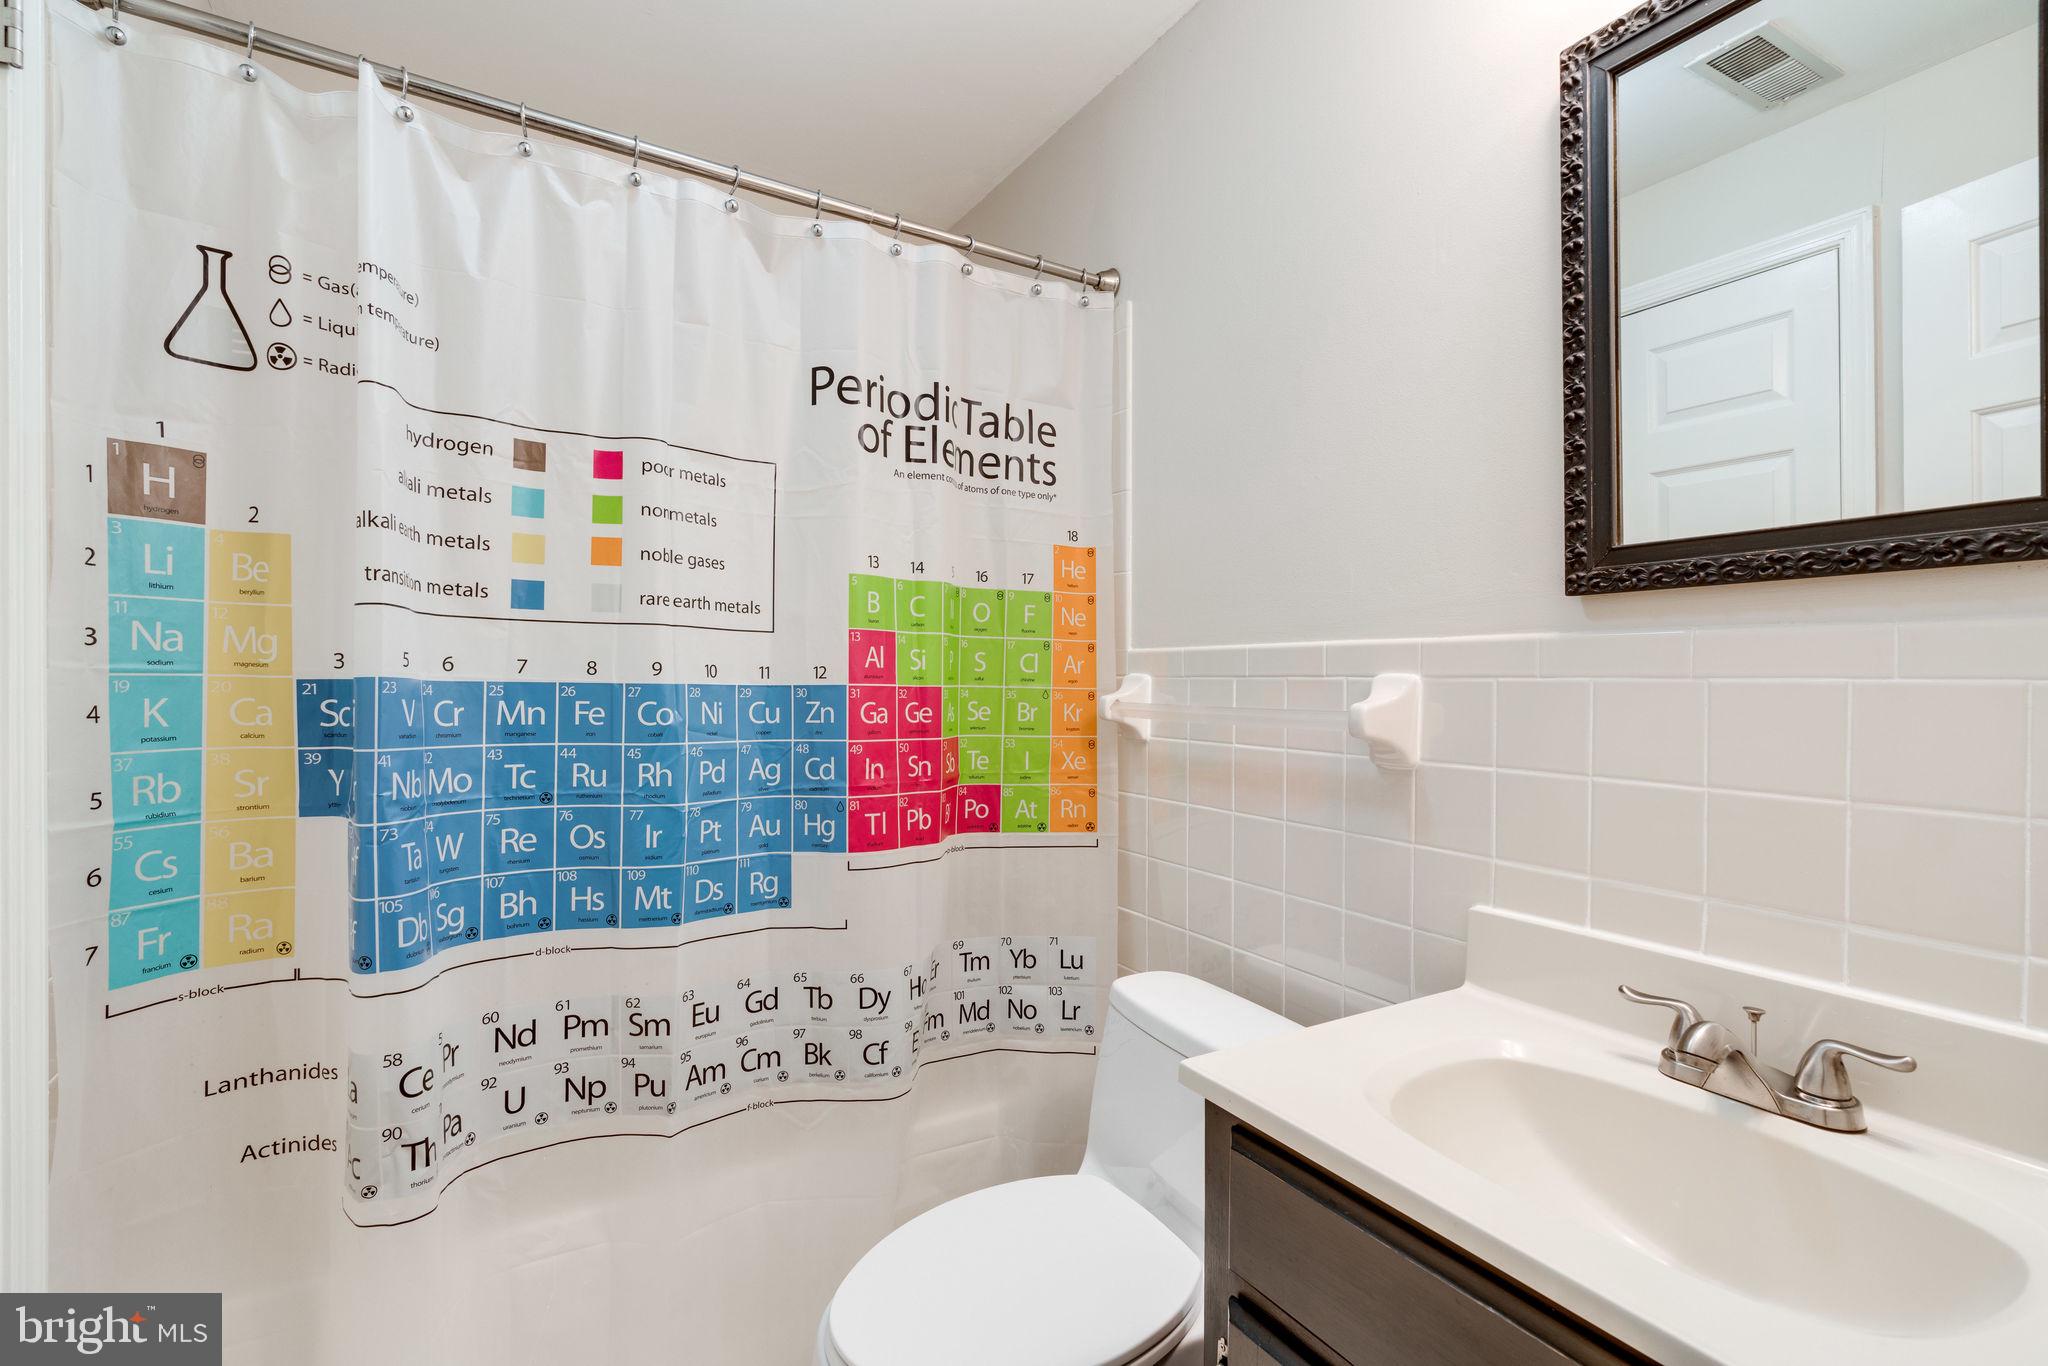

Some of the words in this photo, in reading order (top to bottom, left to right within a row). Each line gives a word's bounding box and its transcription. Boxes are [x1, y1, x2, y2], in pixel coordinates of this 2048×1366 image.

[319, 316, 358, 338] Liqu
[319, 358, 358, 376] Radi
[811, 365, 958, 429] Periodic
[961, 397, 1057, 448] Table
[155, 421, 164, 438] 1
[406, 424, 494, 457] hydrogen
[858, 419, 893, 458] of
[905, 425, 1057, 487] Elements
[86, 464, 92, 482] 1
[143, 463, 175, 498] H
[680, 469, 726, 487] metals
[894, 469, 904, 479] An
[907, 471, 944, 481] element
[964, 485, 988, 494] atoms
[991, 485, 1000, 495] of
[1019, 490, 1035, 499] type
[427, 486, 492, 503] metals
[248, 506, 259, 523] 2
[427, 534, 491, 551] metals
[1067, 531, 1078, 542] 18
[85, 547, 96, 566] 2
[145, 544, 173, 575] Li
[641, 548, 683, 564] noble
[688, 556, 725, 570] gases
[868, 555, 879, 568] 13
[232, 553, 269, 582] Be
[911, 562, 924, 573] 14
[976, 571, 988, 582] 16
[1061, 560, 1086, 579] He
[148, 582, 174, 590] lithium
[1022, 573, 1034, 584] 17
[427, 582, 489, 598] metals
[640, 594, 670, 606] rare
[673, 596, 710, 610] earth
[715, 601, 760, 614] metals
[868, 592, 880, 613] B
[910, 596, 925, 617] C
[973, 603, 990, 623] O
[1025, 605, 1034, 624] F
[84, 627, 97, 645] 3
[131, 620, 183, 652] Na
[223, 625, 278, 663] Mg
[334, 653, 344, 669] 3
[403, 652, 409, 667] 5
[442, 656, 454, 671] 6
[517, 659, 528, 674] 7
[865, 646, 884, 668] Al
[910, 649, 925, 671] Si
[974, 652, 986, 672] S
[1020, 653, 1038, 673] Cl
[587, 661, 597, 675] 8
[652, 662, 662, 676] 9
[705, 664, 717, 678] 10
[759, 666, 769, 679] 11
[814, 666, 827, 679] 12
[302, 684, 317, 694] 21
[489, 686, 504, 696] 25
[561, 686, 575, 696] 26
[740, 689, 751, 697] 29
[86, 705, 100, 723] 4
[144, 698, 169, 728] K
[434, 700, 464, 726] Cr
[497, 700, 545, 725] Mn
[575, 701, 605, 725] Fe
[637, 701, 673, 726] Co
[702, 702, 722, 724] Ni
[749, 701, 780, 724] Cu
[806, 701, 834, 723] Zn
[860, 702, 888, 724] Ga
[905, 702, 932, 723] Ge
[1018, 703, 1037, 722] Br
[141, 735, 177, 744] potassium
[805, 757, 834, 780] Cd
[865, 758, 884, 780] In
[908, 756, 931, 777] Sn
[967, 751, 989, 770] Te
[572, 763, 606, 787] Ru
[638, 762, 672, 787] Rh
[749, 759, 780, 786] Ag
[132, 773, 181, 806] Rb
[90, 792, 102, 810] 5
[965, 800, 989, 818] Po
[486, 815, 500, 825] 75
[749, 815, 780, 837] Au
[804, 814, 835, 842] Hg
[907, 809, 931, 831] Pb
[501, 828, 537, 854] Re
[570, 825, 605, 849] Os
[646, 824, 662, 848] Ir
[700, 820, 721, 843] Pt
[135, 850, 177, 881] Cs
[87, 868, 102, 887] 6
[557, 871, 577, 881] 108
[572, 887, 604, 911] Hs
[635, 886, 672, 910] Mt
[229, 914, 273, 943] Ra
[138, 927, 172, 960] Fr
[535, 946, 571, 956] d-block
[85, 946, 98, 966] 7
[959, 952, 989, 972] Tm
[1010, 949, 1036, 969] Yb
[1061, 950, 1083, 969] Lu
[850, 974, 864, 983] 66
[179, 985, 224, 1001] s-block
[745, 987, 778, 1013] Gd
[803, 987, 832, 1009] Tb
[859, 987, 891, 1014] Dy
[999, 986, 1012, 995] 102
[555, 1000, 570, 1011] 61
[625, 998, 640, 1008] 62
[1008, 999, 1037, 1019] No
[482, 1012, 499, 1024] 60
[564, 1015, 608, 1039] Pm
[629, 1013, 670, 1037] Sm
[495, 1019, 536, 1052] Nd
[849, 1030, 862, 1039] 98
[741, 1049, 781, 1072] Cm
[805, 1043, 832, 1065] Bk
[863, 1041, 889, 1065] Cf
[554, 1063, 569, 1074] 93
[204, 1063, 338, 1097] Lanthanides
[635, 1073, 665, 1097] Pu
[505, 1087, 525, 1114] U
[566, 1076, 606, 1105] Np
[747, 1099, 774, 1111] f-block
[382, 1127, 402, 1142] 90
[240, 1134, 337, 1163] Actinides
[401, 1137, 436, 1171] Th
